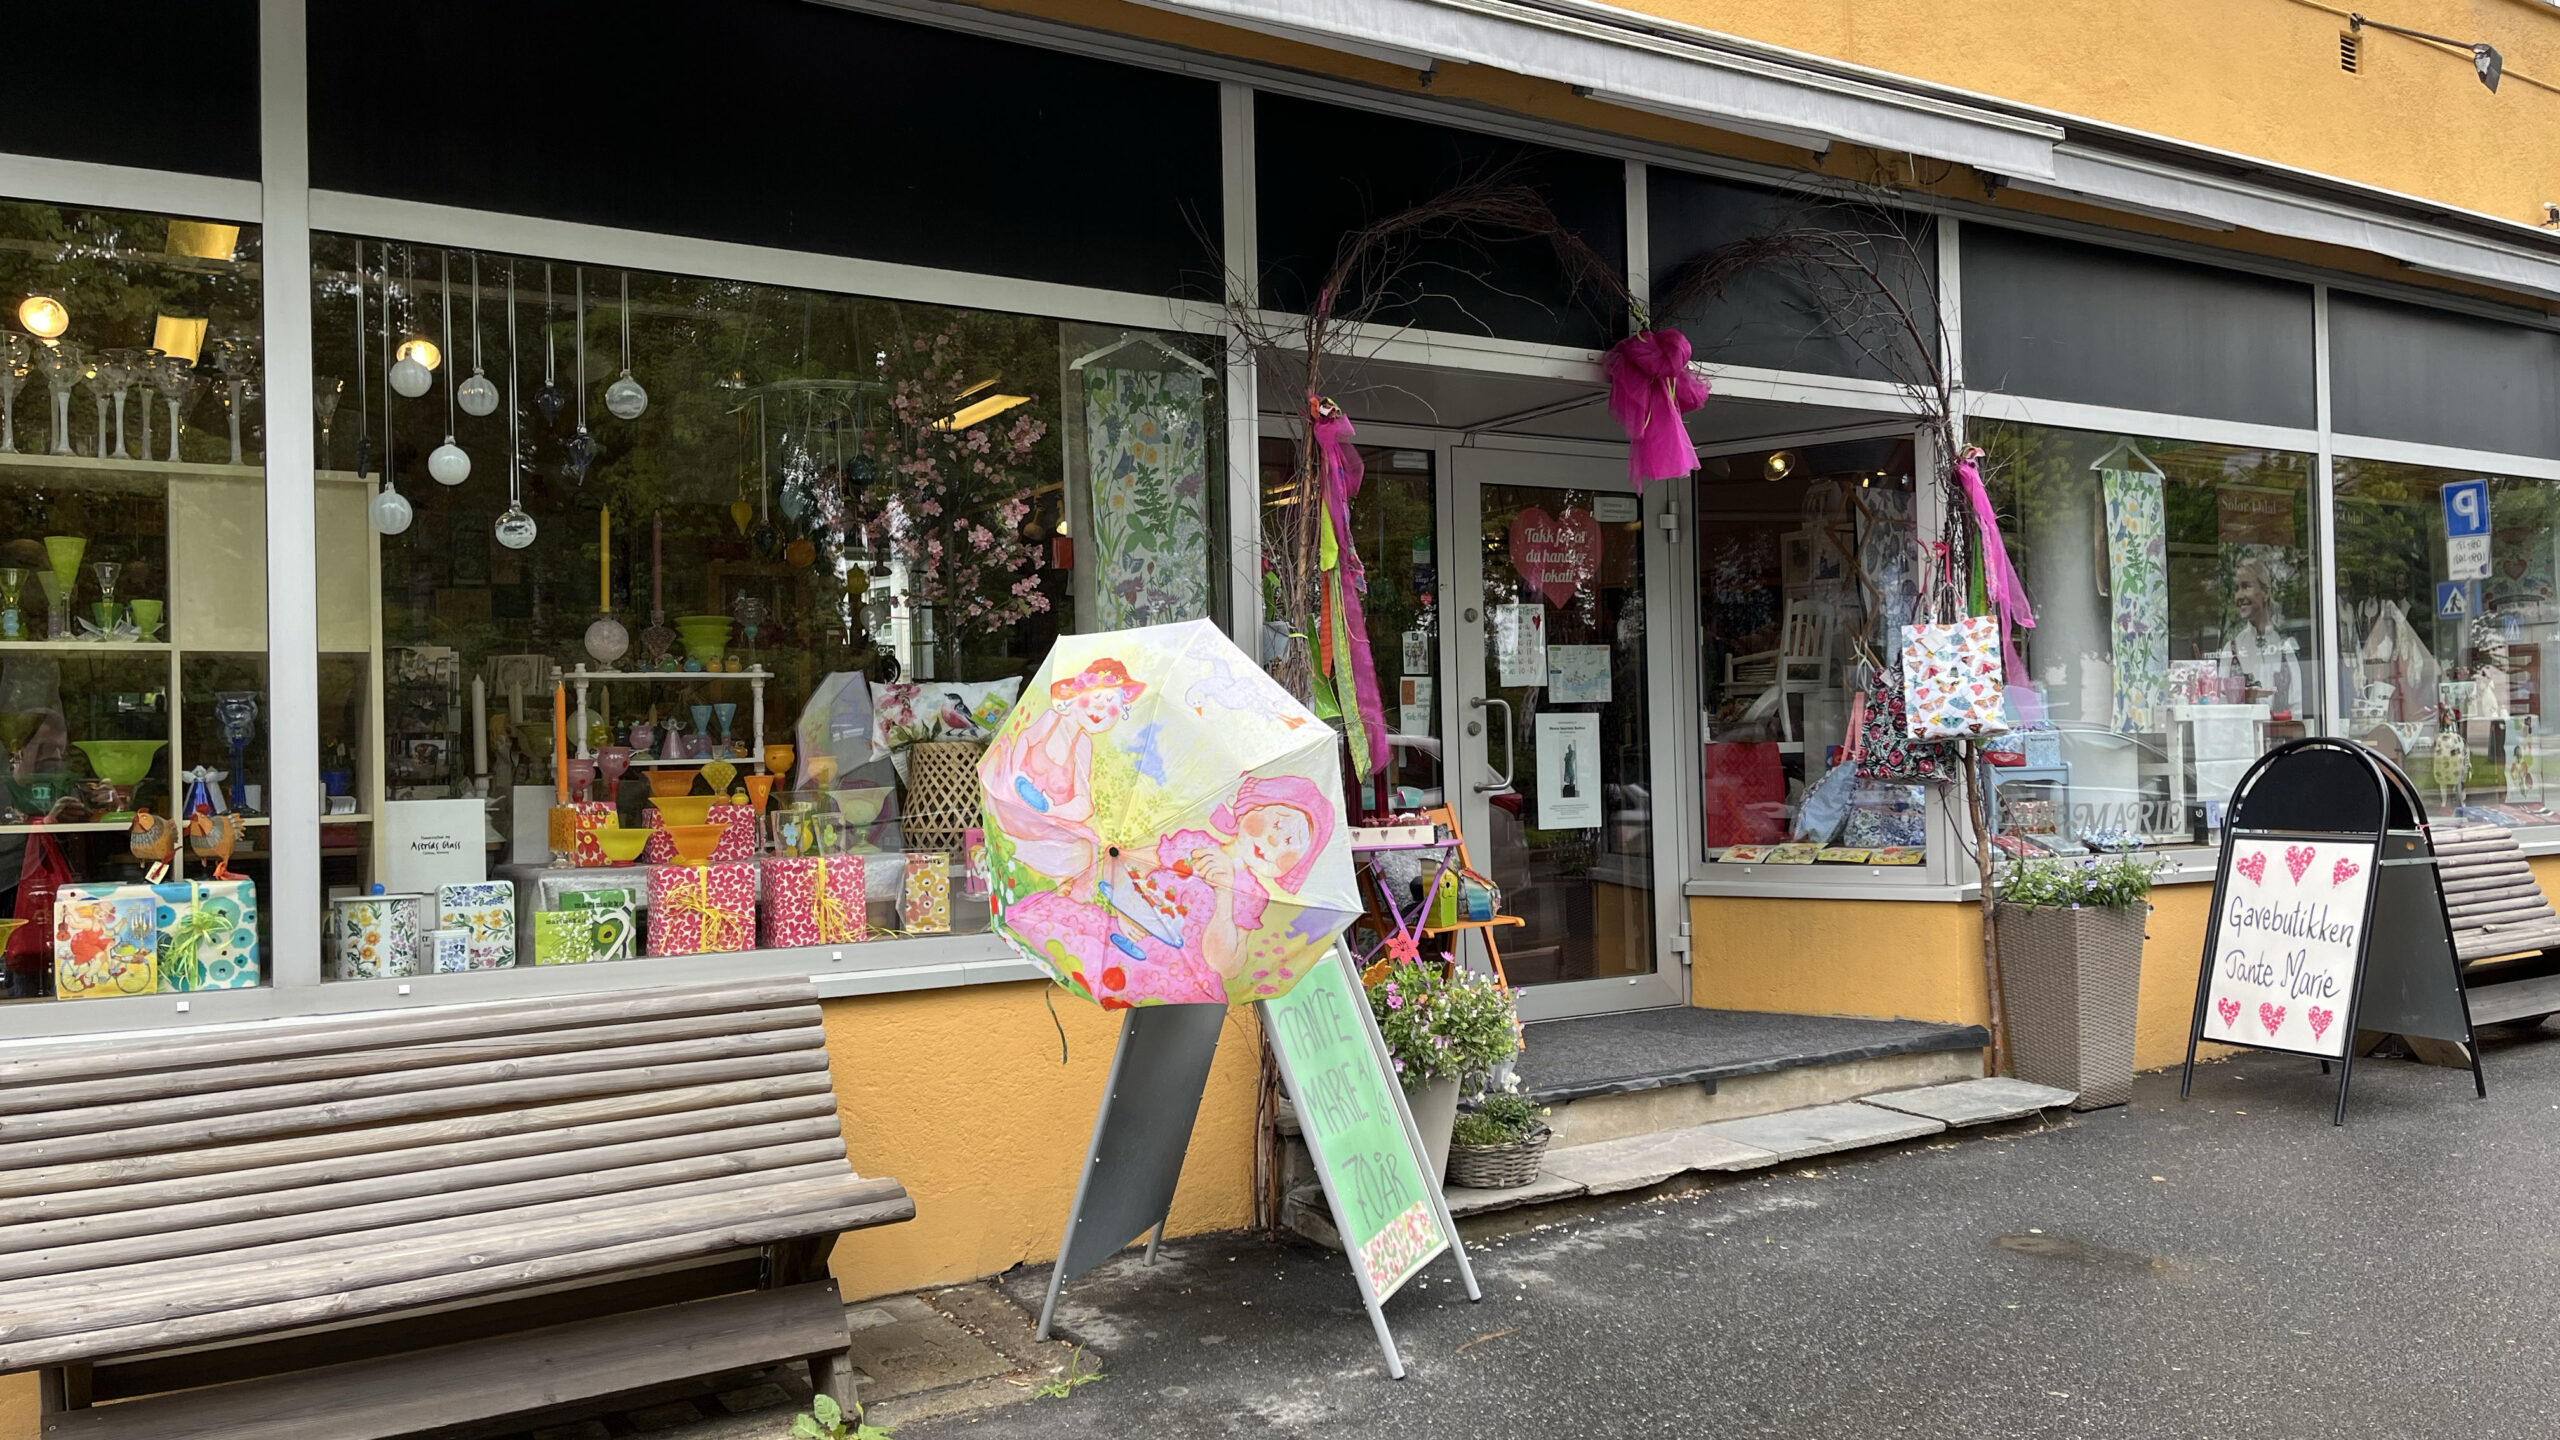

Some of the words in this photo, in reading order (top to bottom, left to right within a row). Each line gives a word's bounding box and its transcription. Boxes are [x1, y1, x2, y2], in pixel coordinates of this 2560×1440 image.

[1525, 527, 1553, 543] Takk
[1526, 549, 1541, 563] du
[442, 840, 461, 850] Glass
[2229, 896, 2355, 948] Gavebutikken
[2225, 949, 2274, 988] Tante
[2280, 949, 2341, 1001] Marie
[1278, 988, 1353, 1061] TANTE
[1302, 1061, 1370, 1138] MARIE
